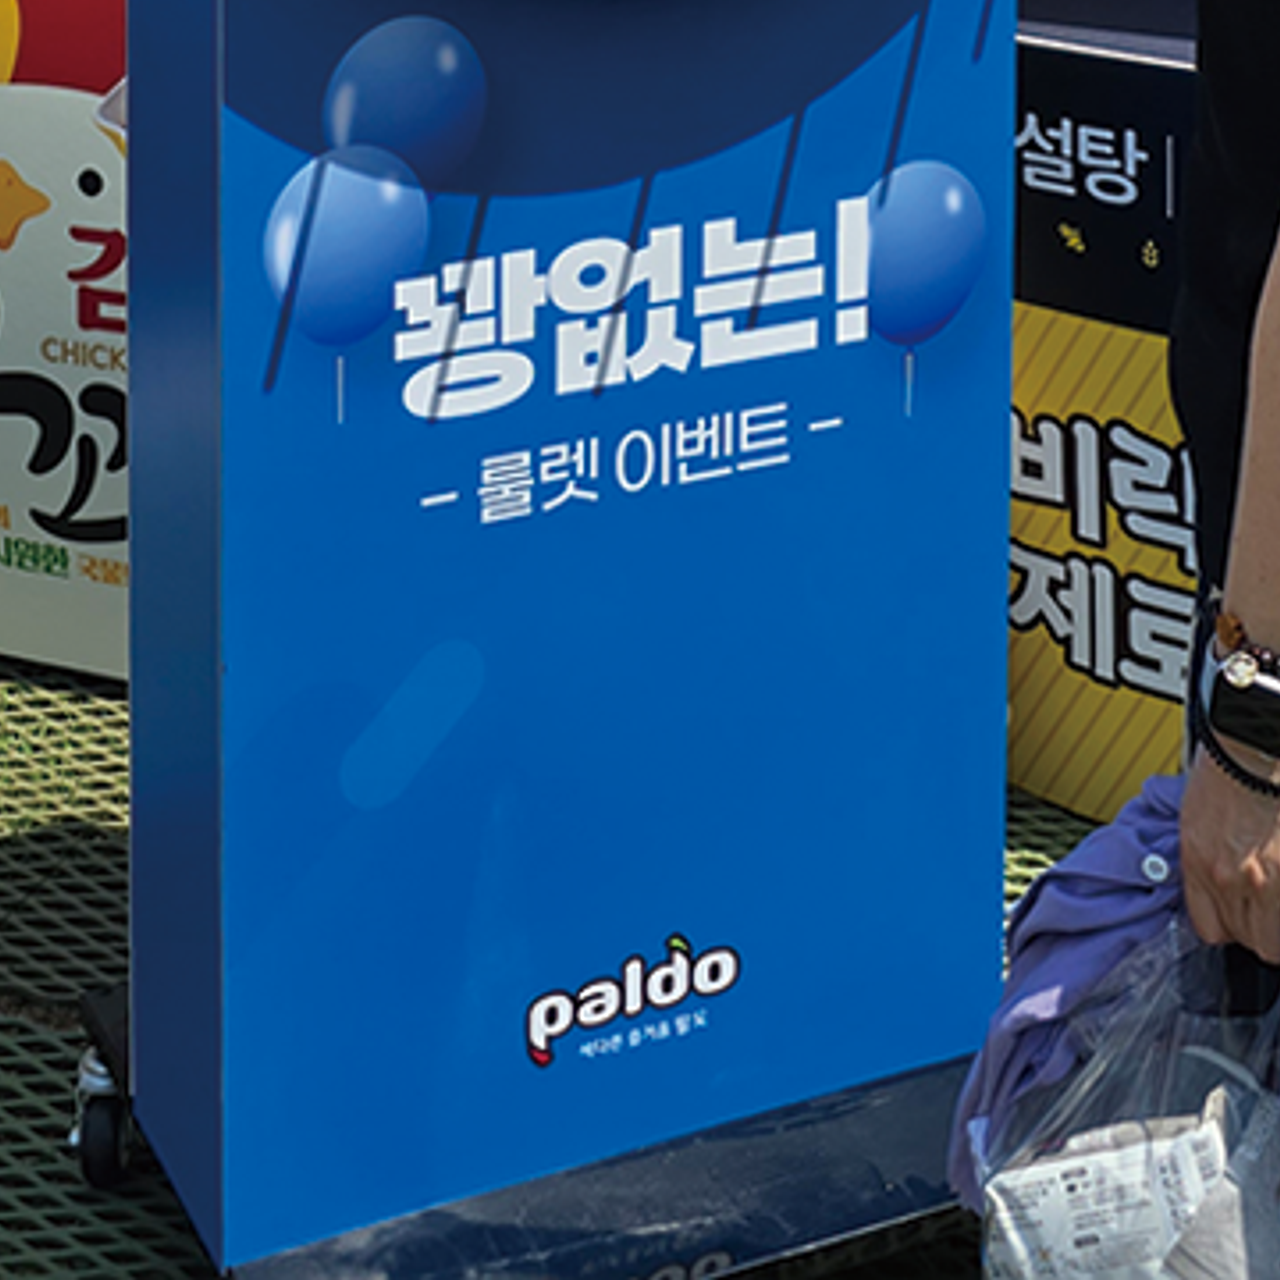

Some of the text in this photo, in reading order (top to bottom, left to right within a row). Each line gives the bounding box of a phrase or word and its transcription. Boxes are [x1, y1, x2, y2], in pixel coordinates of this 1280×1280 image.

[1014, 112, 1149, 205] 설탕
[394, 196, 871, 420] 꽝없는!
[477, 402, 791, 524] 룰렛 이벤트
[526, 933, 742, 1067] paldo
